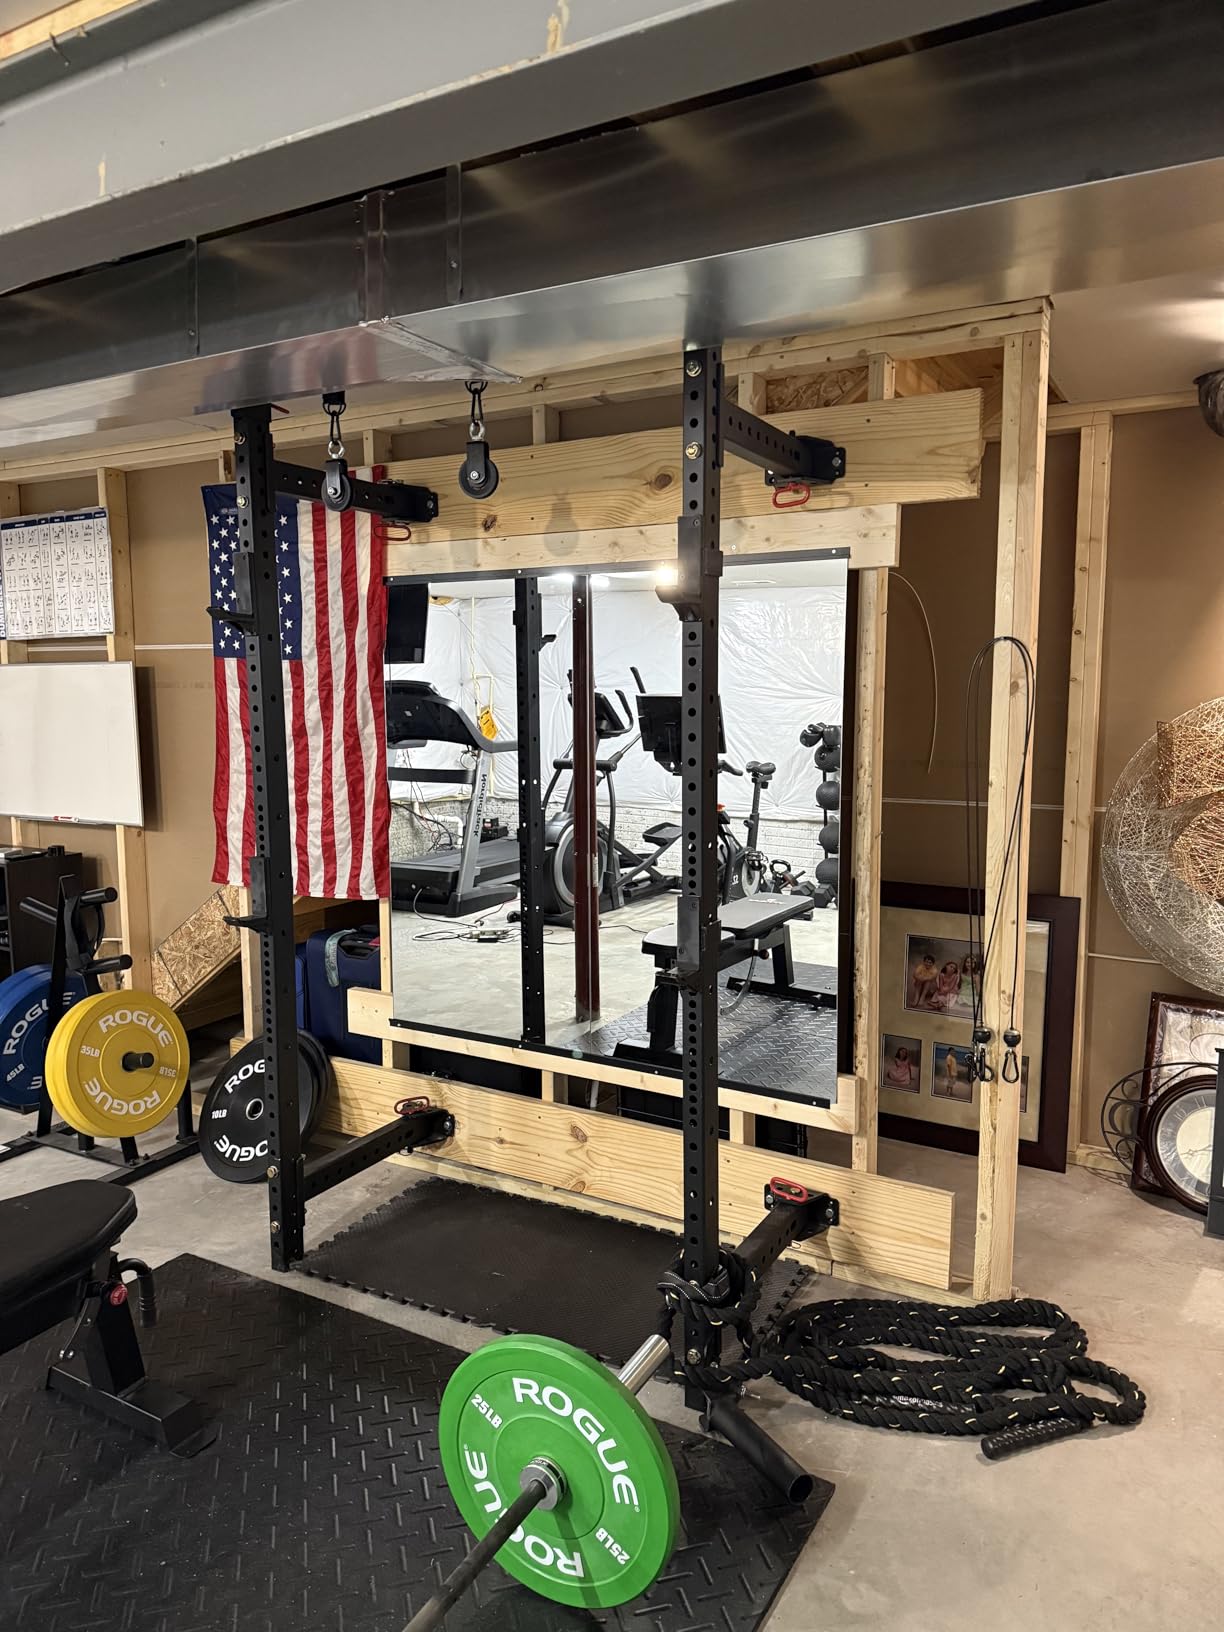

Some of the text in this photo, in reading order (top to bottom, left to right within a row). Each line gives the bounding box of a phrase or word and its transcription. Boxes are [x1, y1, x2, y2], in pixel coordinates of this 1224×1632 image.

[98, 1009, 173, 1048] ROGUE
[80, 1045, 100, 1058] 35LB
[6, 1063, 25, 1082] 45LB
[159, 1066, 177, 1078] 35LB
[224, 1059, 266, 1094] ROG
[84, 1077, 161, 1115] ROGUE
[211, 1109, 228, 1119] 10LB
[214, 1134, 269, 1161] OGUE
[471, 1393, 503, 1429] 25LB
[512, 1377, 639, 1507] ROGUE
[595, 1527, 631, 1565] 25LB
